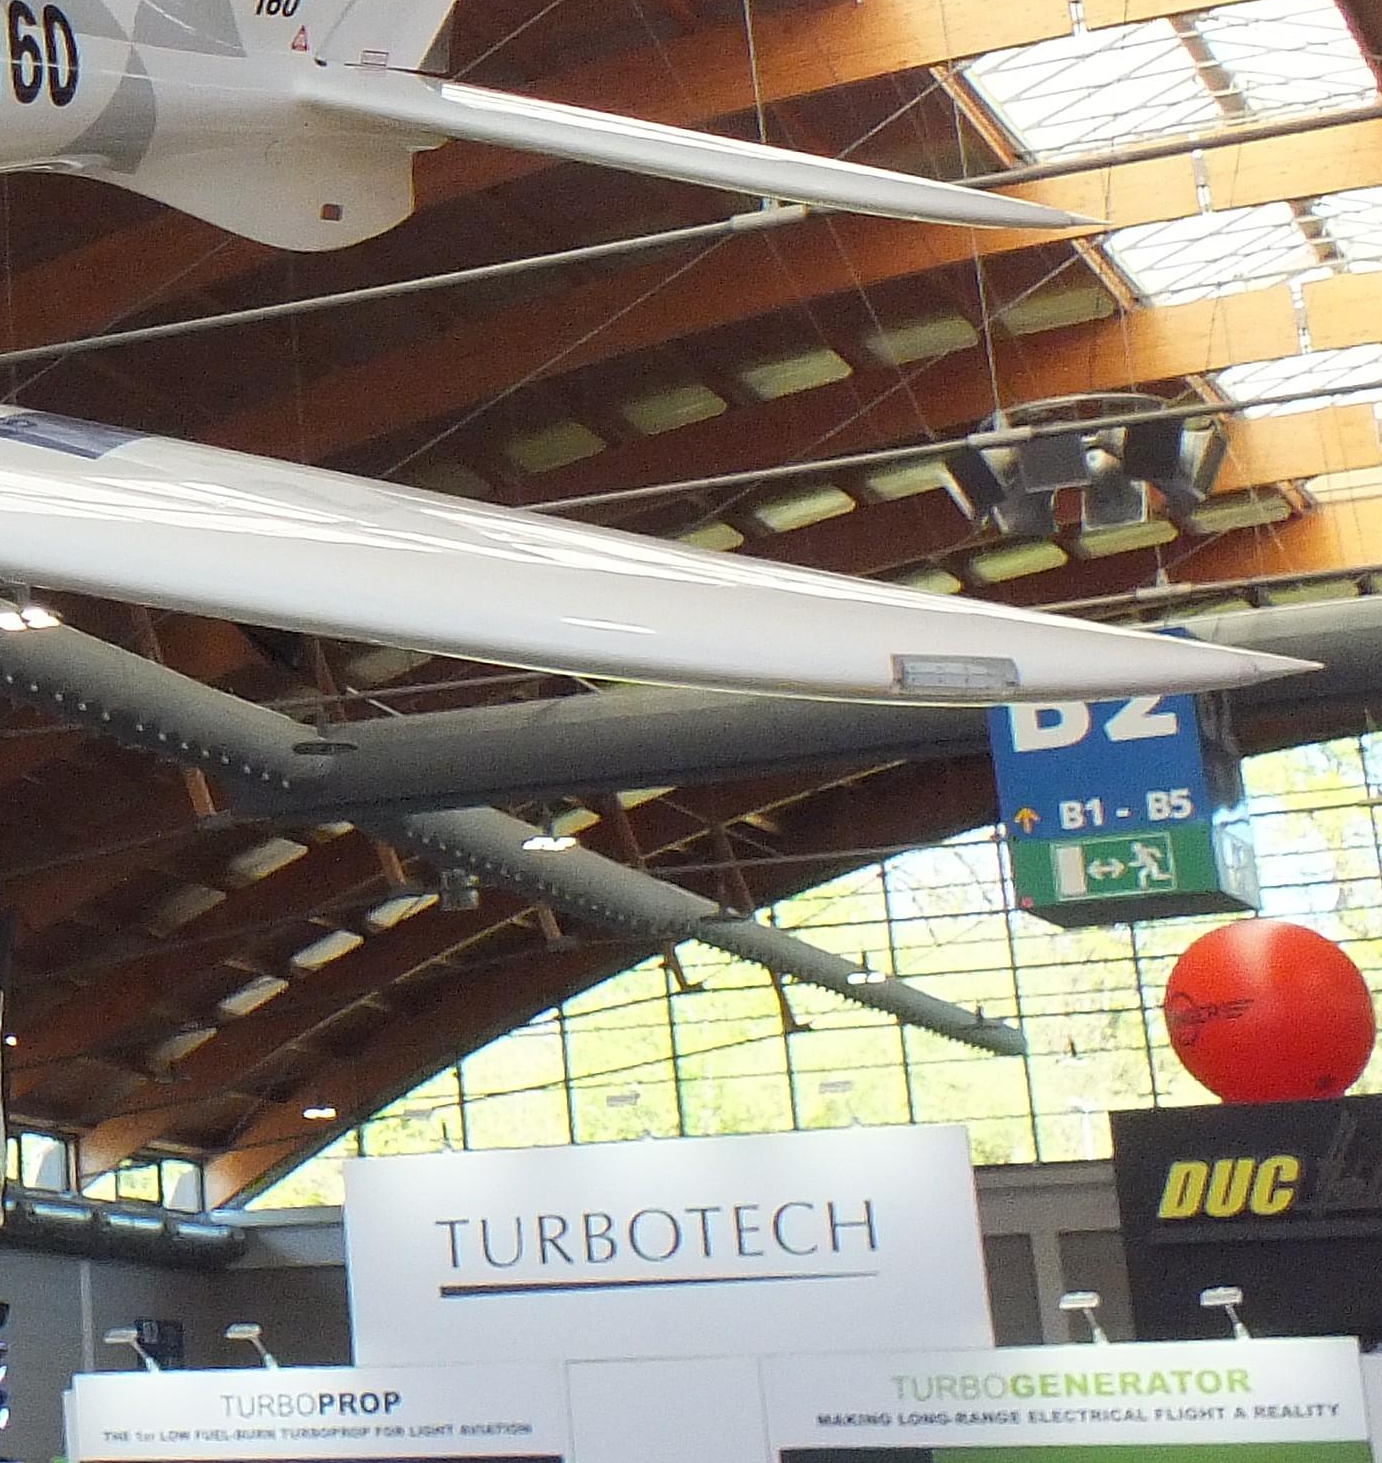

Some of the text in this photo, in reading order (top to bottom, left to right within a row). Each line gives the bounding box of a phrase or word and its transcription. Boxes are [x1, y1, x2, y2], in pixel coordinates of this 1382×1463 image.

[1058, 797, 1103, 830] B1
[1145, 787, 1192, 823] B5
[1157, 1153, 1301, 1220] DUC
[435, 1198, 878, 1270] TURBOTECH
[891, 1367, 1254, 1402] TURBOGENERATOR
[220, 1390, 403, 1419] TURBOPROP
[816, 1413, 892, 1427] MAKING
[1028, 1408, 1148, 1423] ELECTRICAL
[1154, 1407, 1225, 1421] FLIGHT
[1254, 1403, 1340, 1419] REALITY
